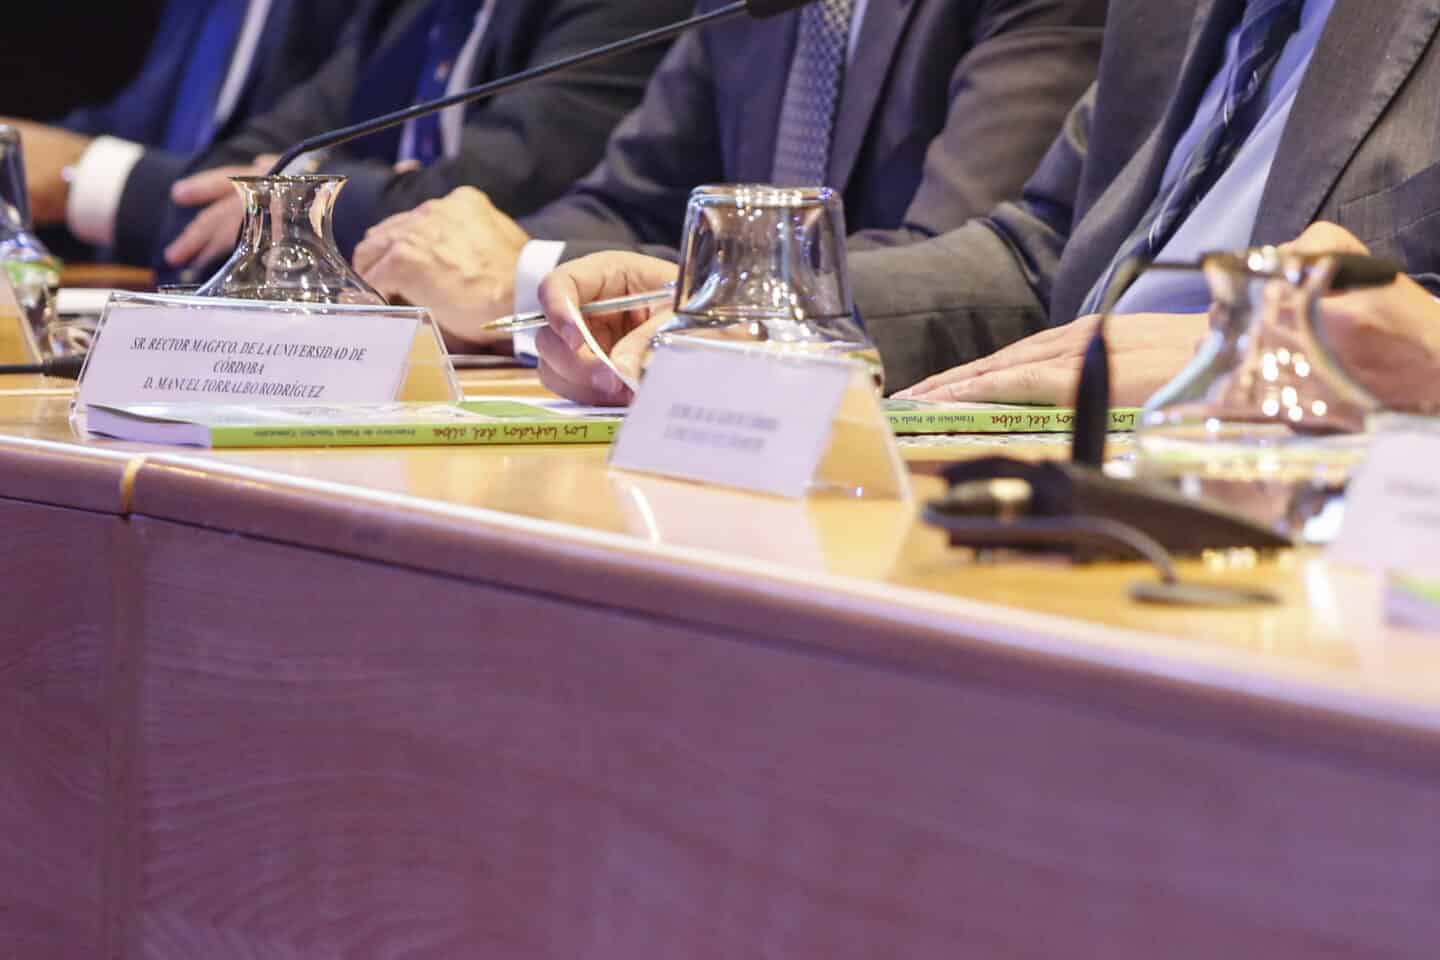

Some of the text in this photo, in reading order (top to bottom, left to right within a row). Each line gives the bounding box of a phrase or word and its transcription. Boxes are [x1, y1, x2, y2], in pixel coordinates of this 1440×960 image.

[129, 336, 146, 351] SR.
[147, 337, 191, 353] RECTOR
[239, 341, 259, 355] DE
[256, 342, 273, 356] LA
[272, 343, 348, 360] UNIVERSIDAD
[347, 346, 368, 361] DE
[212, 355, 265, 375] CÓRDOBA
[142, 376, 326, 399] D. MANUEL TORRALBO RODRÍGUEZ
[991, 415, 1023, 429] alba
[1026, 414, 1051, 429] del
[1112, 413, 1136, 426] Los
[432, 424, 589, 441] Los latidos del alba
